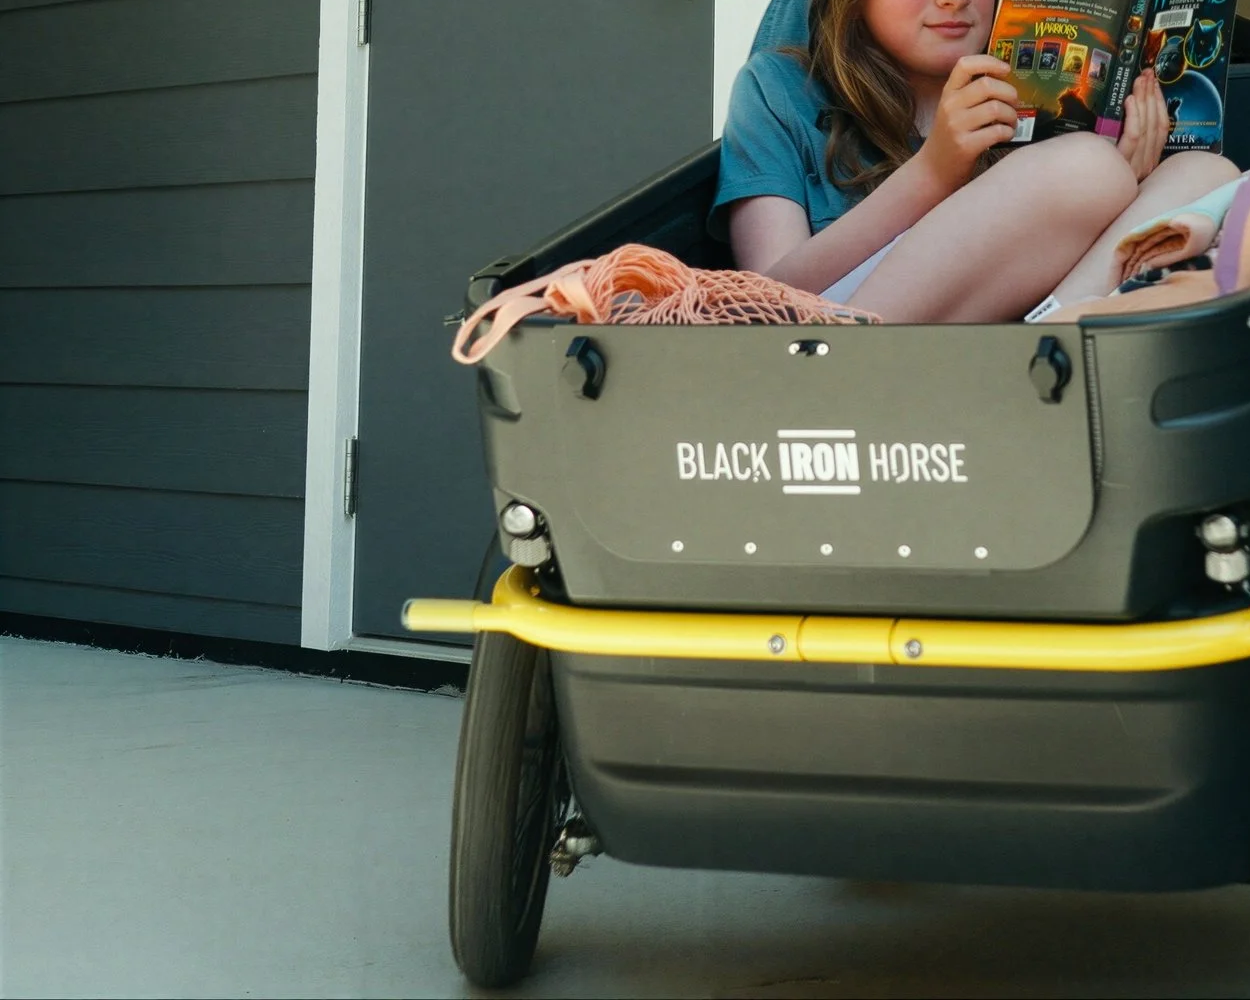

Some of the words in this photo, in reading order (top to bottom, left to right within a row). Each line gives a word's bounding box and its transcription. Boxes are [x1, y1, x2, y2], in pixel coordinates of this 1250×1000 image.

[1035, 21, 1079, 40] WARRIORS
[1168, 134, 1195, 143] NTER
[676, 442, 772, 482] BLACK
[778, 442, 860, 481] IRON
[868, 442, 969, 483] HORSE
